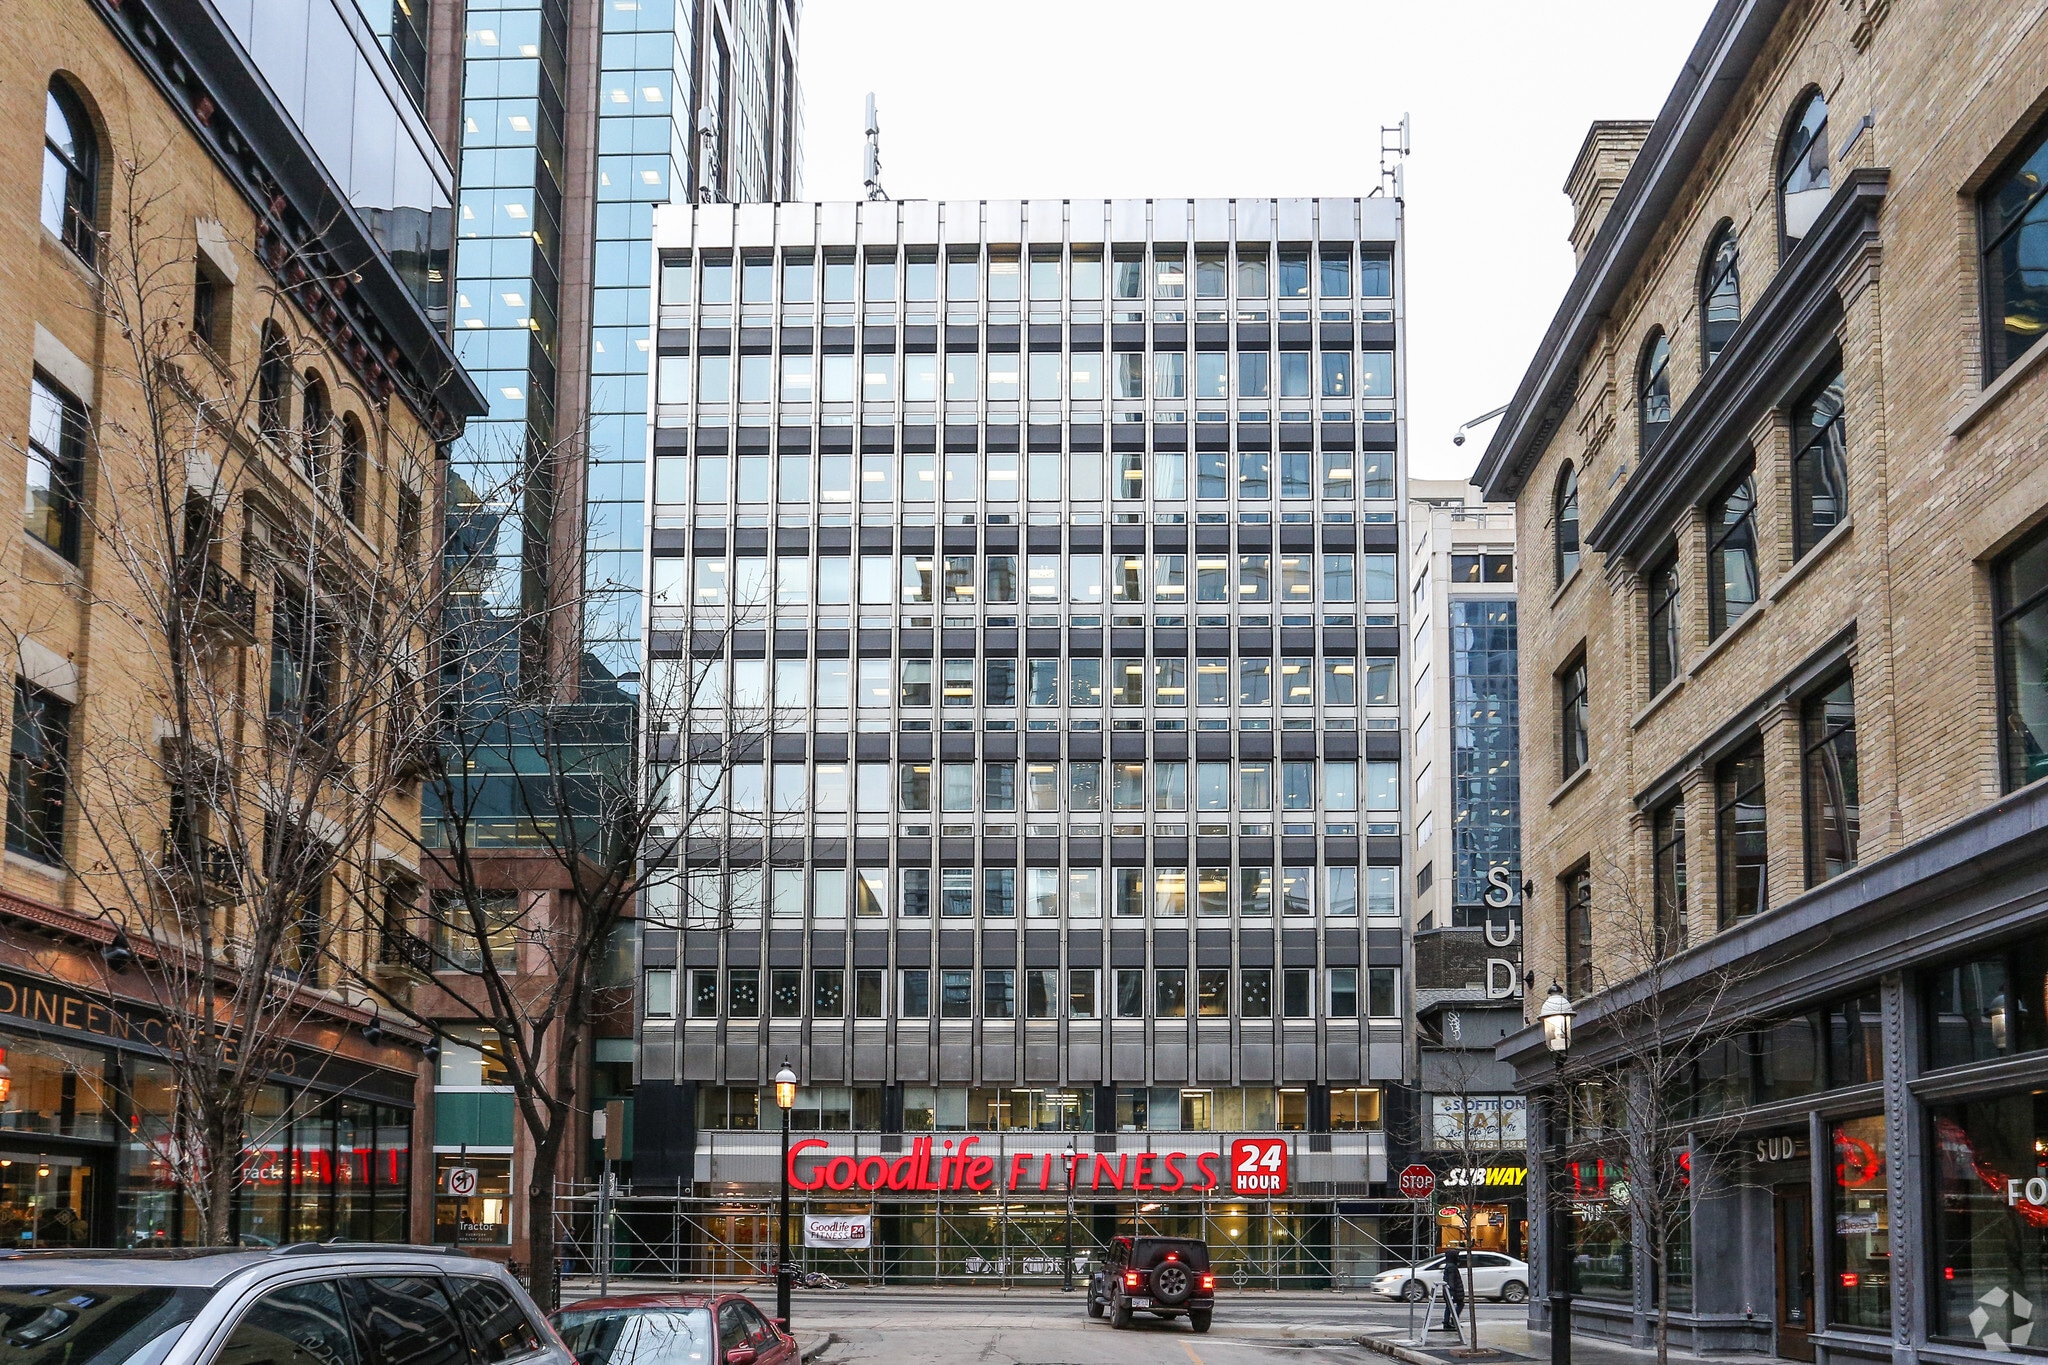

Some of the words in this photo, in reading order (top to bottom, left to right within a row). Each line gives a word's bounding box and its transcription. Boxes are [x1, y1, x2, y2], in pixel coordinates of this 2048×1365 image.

[1484, 866, 1517, 999] SUD
[0, 980, 130, 1040] DINEEN
[1450, 1112, 1514, 1130] TAX
[1445, 1128, 1462, 1139] Let
[1756, 1135, 1796, 1162] SUD
[788, 1136, 994, 1191] GoodLife
[1008, 1152, 1220, 1191] FITNESS
[1237, 1145, 1282, 1172] 24
[1237, 1175, 1281, 1190] HOUR
[1401, 1174, 1434, 1189] STOP
[1443, 1167, 1528, 1187] SUBWAY
[460, 1221, 494, 1231] Tractor
[810, 1221, 850, 1232] GoodLife
[851, 1226, 864, 1234] 24
[810, 1232, 849, 1240] FITNESS
